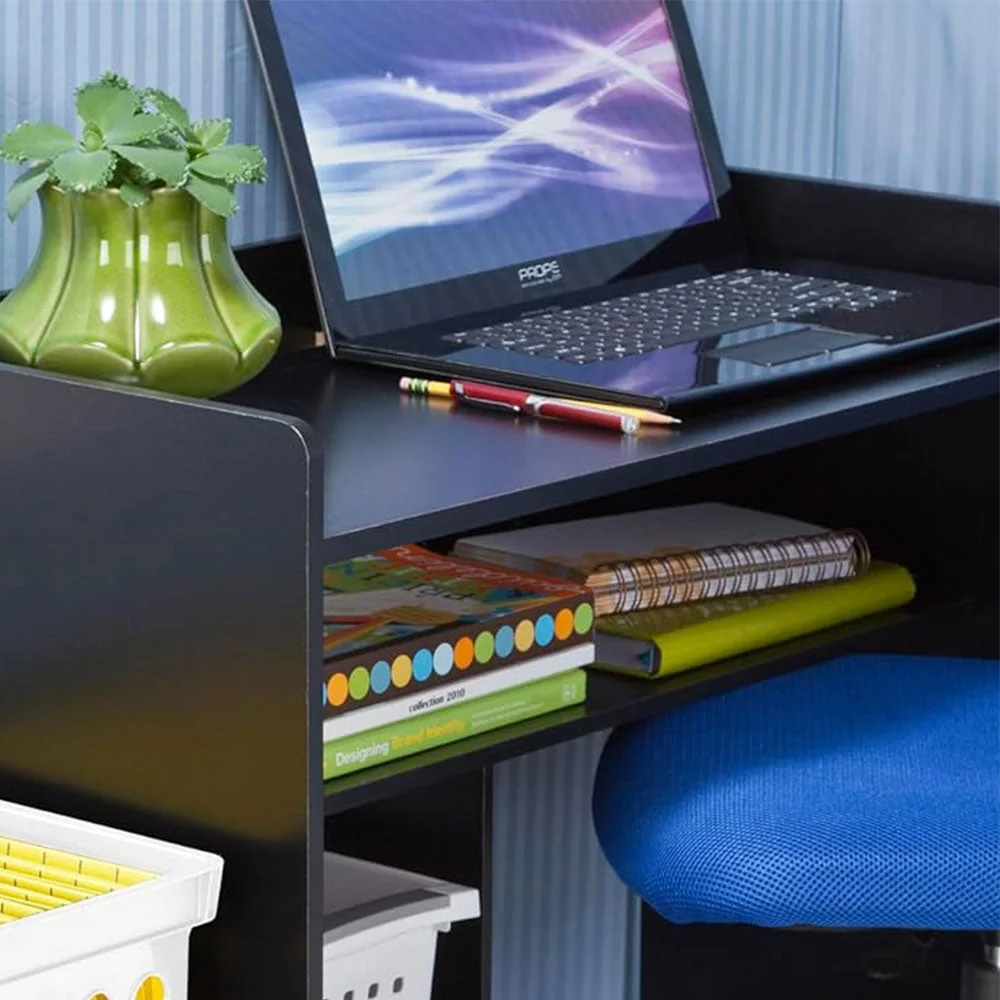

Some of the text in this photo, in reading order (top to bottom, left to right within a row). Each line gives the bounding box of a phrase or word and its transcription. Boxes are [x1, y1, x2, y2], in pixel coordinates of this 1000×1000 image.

[408, 688, 466, 713] collection 2010
[335, 742, 389, 766] Designing
